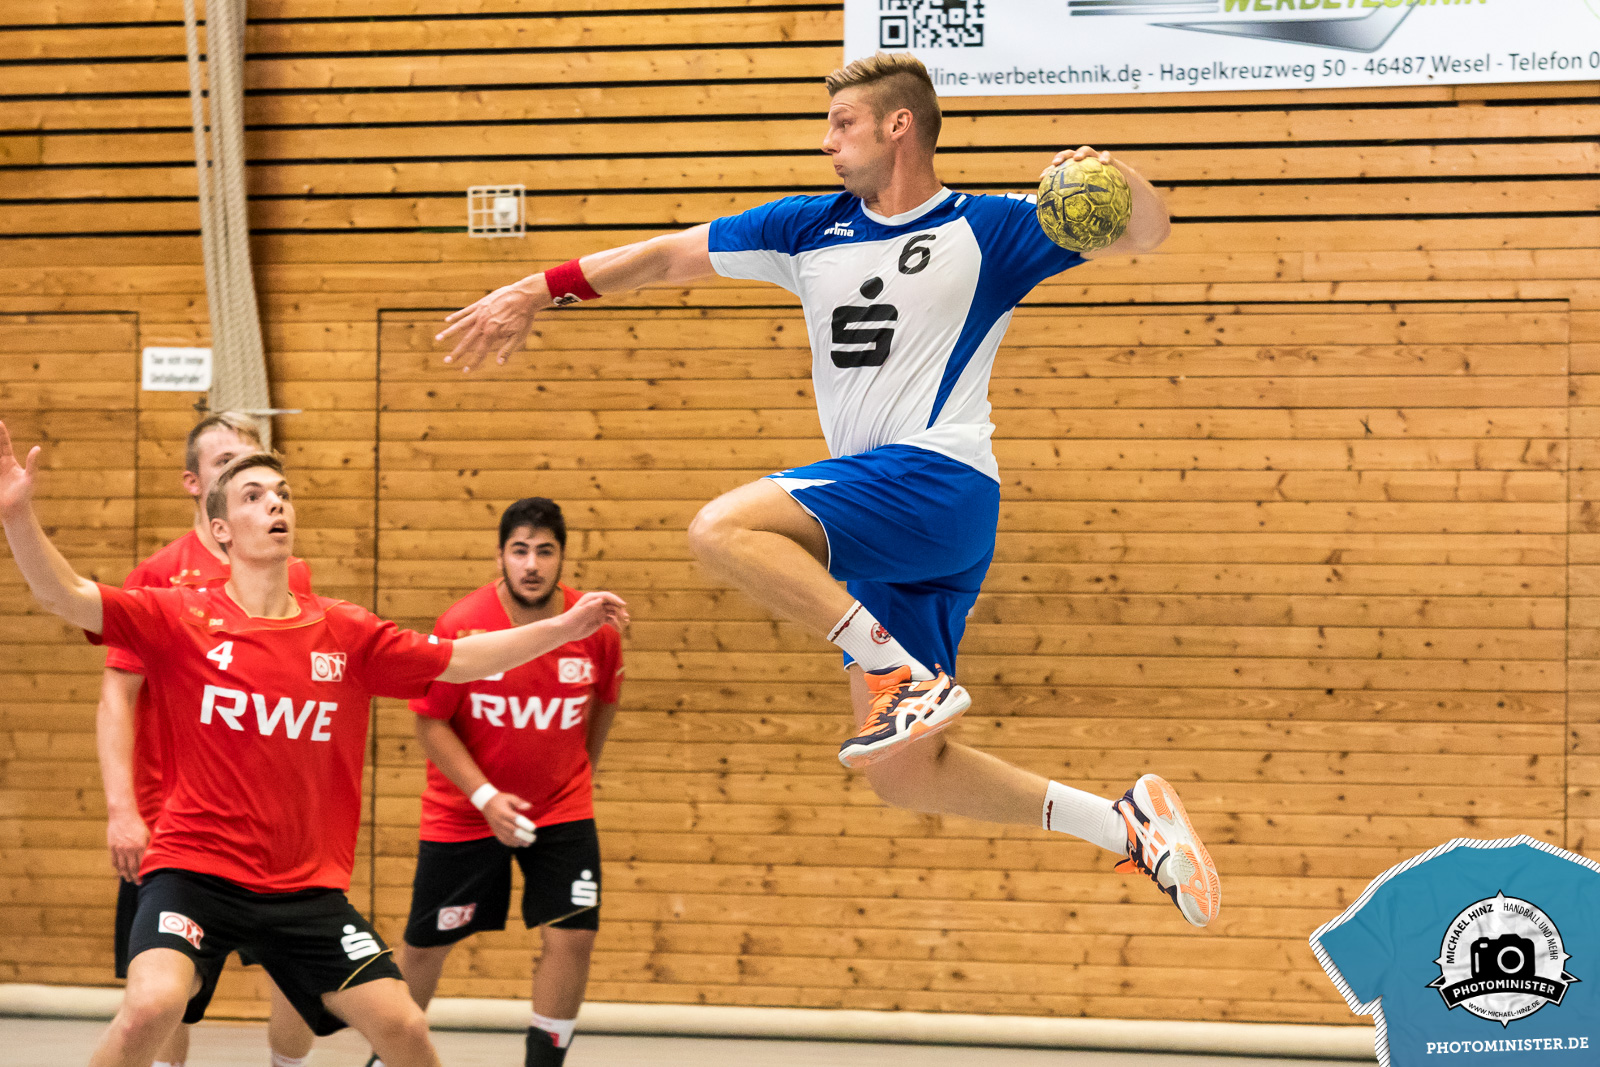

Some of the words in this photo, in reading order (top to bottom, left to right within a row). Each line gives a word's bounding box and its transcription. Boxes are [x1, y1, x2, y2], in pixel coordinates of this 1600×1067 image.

[928, 64, 1141, 86] iline-werbetechnik.de
[1160, 60, 1315, 85] Hagelkreuzweg
[1322, 59, 1346, 77] 50
[1364, 56, 1425, 75] 46487
[1431, 53, 1490, 73] Wesel
[1508, 51, 1582, 71] Telefon
[898, 234, 936, 274] 6
[206, 641, 234, 671] 4
[200, 684, 338, 742] RWE
[470, 693, 589, 730] RWE
